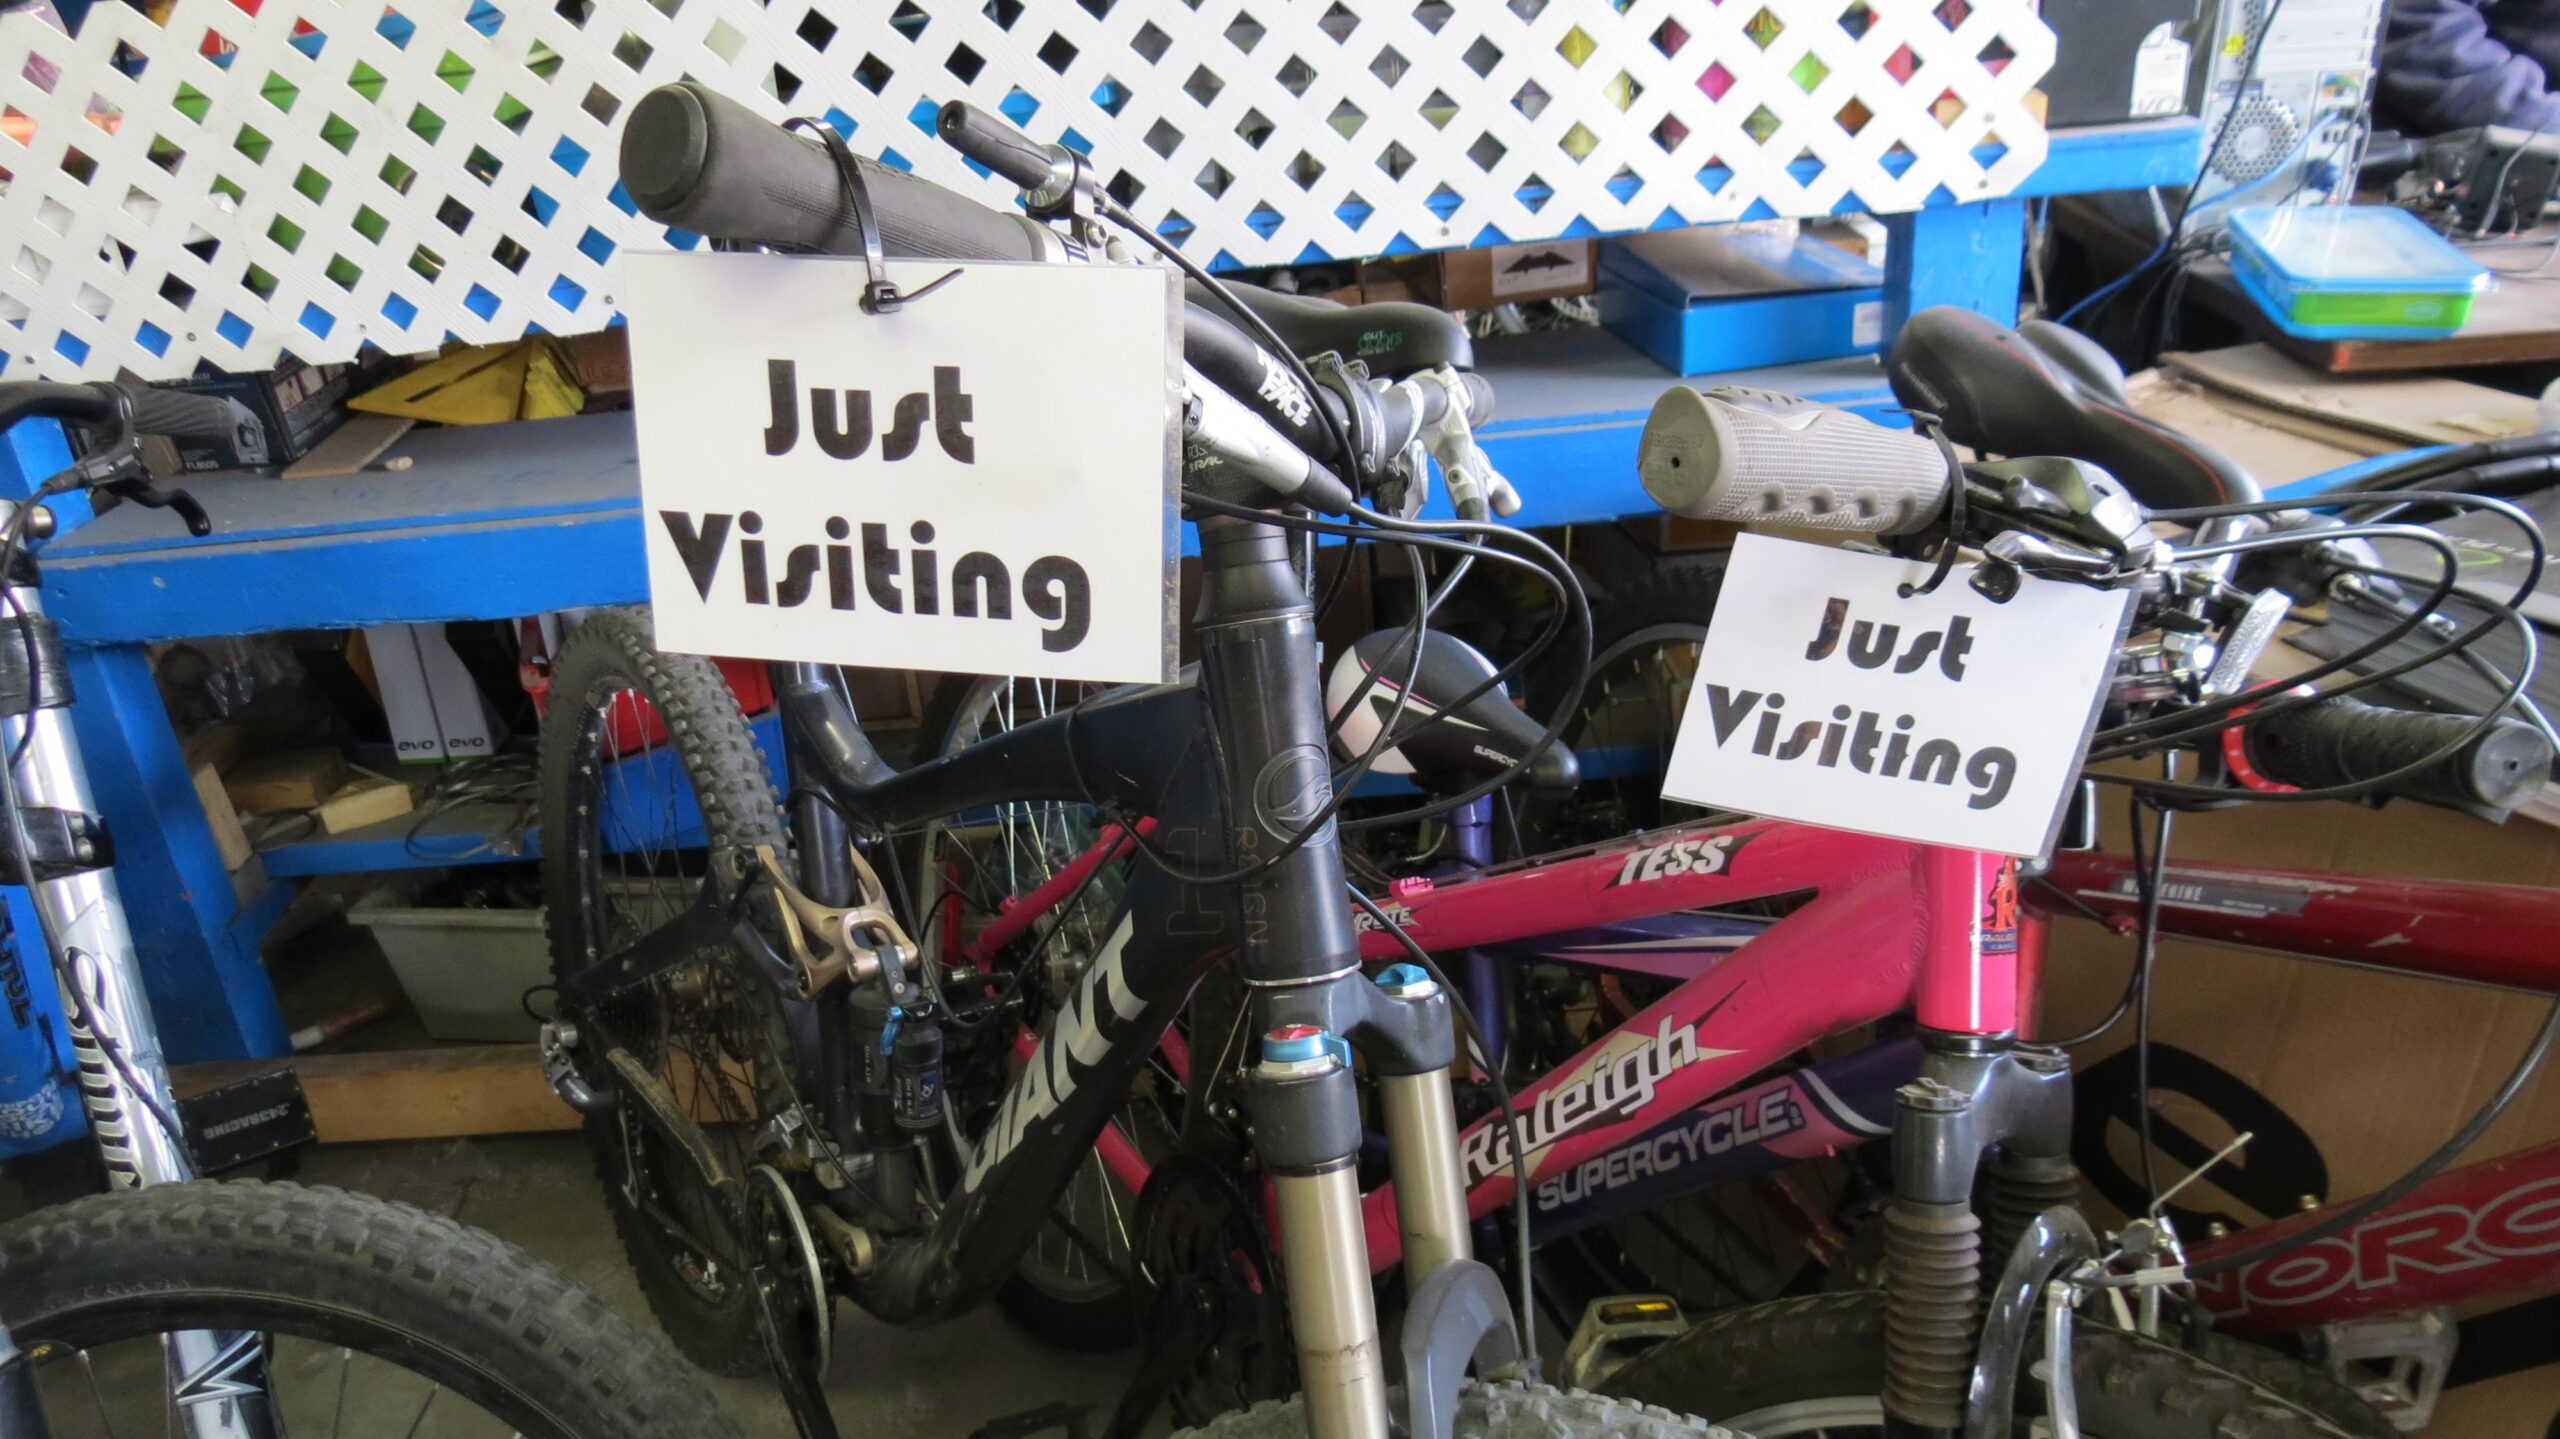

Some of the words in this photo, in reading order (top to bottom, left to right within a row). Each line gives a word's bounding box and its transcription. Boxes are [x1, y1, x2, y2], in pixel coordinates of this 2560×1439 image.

[764, 359, 975, 464] Just
[1257, 376, 1312, 428] FACE
[659, 510, 1091, 653] Visiting
[1805, 597, 1975, 682] Just
[398, 740, 434, 751] evo
[449, 737, 485, 748] evo
[1706, 683, 2017, 810] Visiting
[1617, 835, 1735, 888] TESS
[965, 909, 1149, 1194] GIANT
[1461, 1015, 1699, 1188] Raleigh
[1537, 1088, 1791, 1212] SUPERCYCLE
